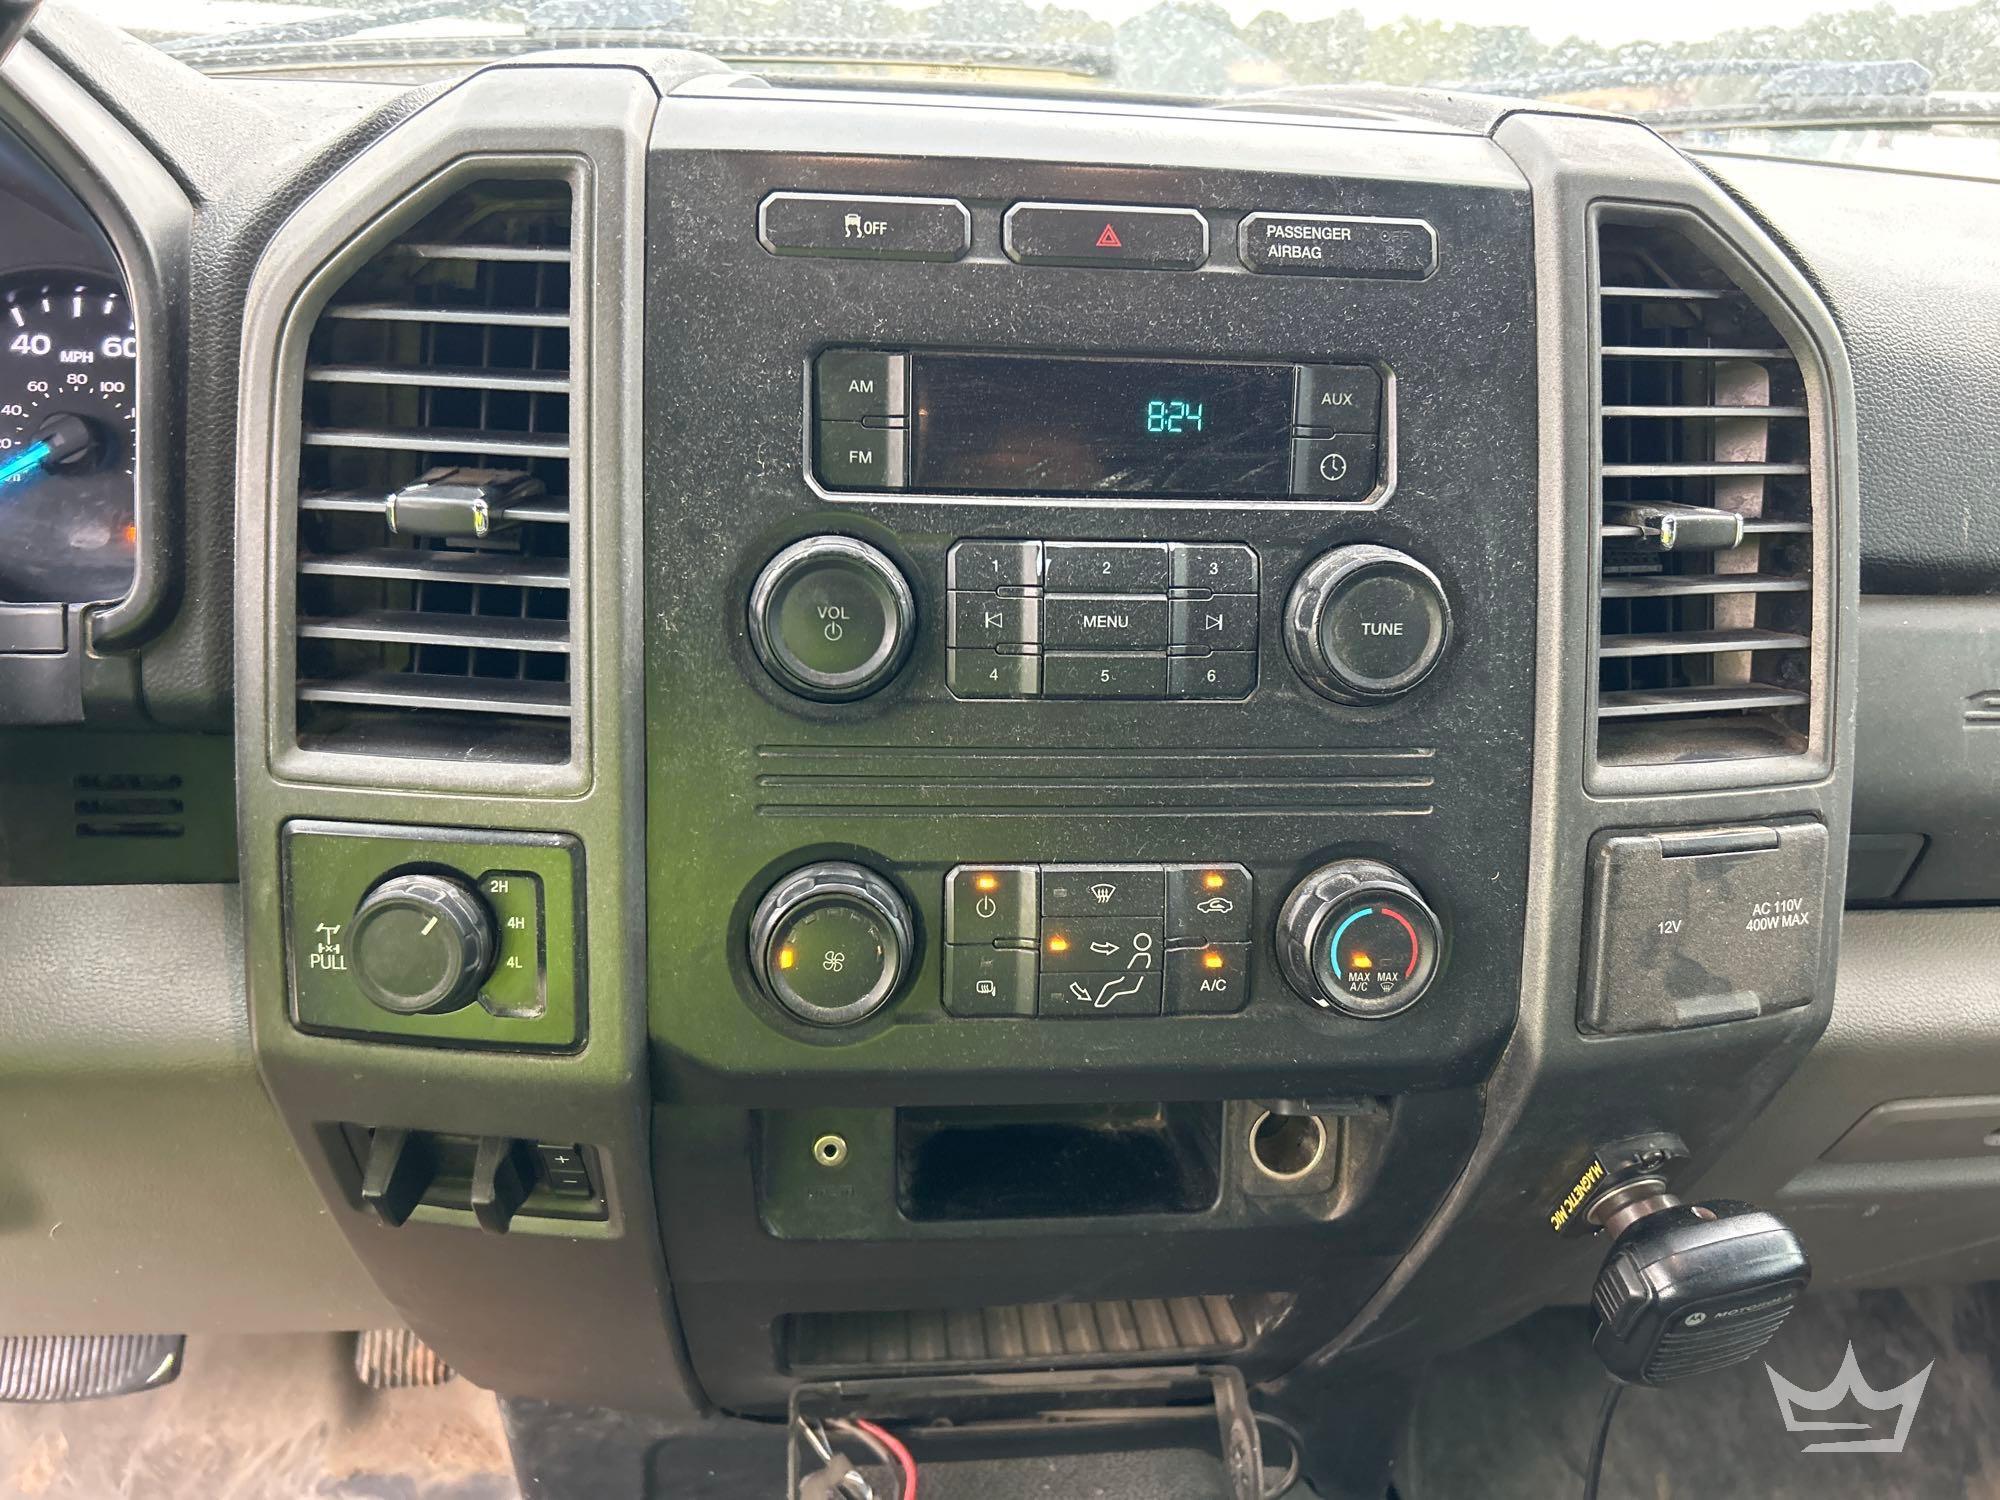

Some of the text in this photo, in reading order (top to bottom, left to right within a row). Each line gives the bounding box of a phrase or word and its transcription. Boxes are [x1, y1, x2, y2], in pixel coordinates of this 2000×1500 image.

[864, 222, 887, 234] OFF
[1267, 225, 1350, 240] PASSENGER
[1268, 243, 1321, 259] AIRBAG
[10, 334, 51, 356] 40
[103, 336, 136, 358] 60
[59, 350, 94, 364] MPH
[66, 373, 88, 385] 80
[27, 381, 49, 392] 60
[100, 381, 126, 393] 100
[849, 380, 873, 392] AM
[1321, 393, 1352, 405] AUX
[0, 404, 23, 416] 40
[1147, 401, 1203, 432] 8:24
[850, 451, 871, 463] FM
[991, 560, 999, 573] 1
[1102, 562, 1111, 575] 2
[1208, 563, 1219, 575] 3
[818, 607, 849, 619] VOL
[1084, 615, 1128, 627] MENU
[1362, 623, 1403, 635] TUNE
[989, 669, 999, 681] 4
[1100, 670, 1110, 683] 5
[1207, 670, 1217, 683] 6
[490, 880, 509, 893] 2H
[1752, 898, 1803, 916] AC 110V
[507, 917, 525, 929] 4H
[1657, 920, 1682, 934] 12V
[1746, 912, 1809, 932] 400W MAX
[311, 954, 347, 971] PULL
[507, 956, 523, 968] 4L
[1348, 972, 1370, 982] MAX
[1377, 972, 1398, 982] MAX
[1200, 979, 1226, 991] A/C
[1349, 982, 1368, 992] A/C
[1550, 1160, 1604, 1231] MAGNETIC MIC
